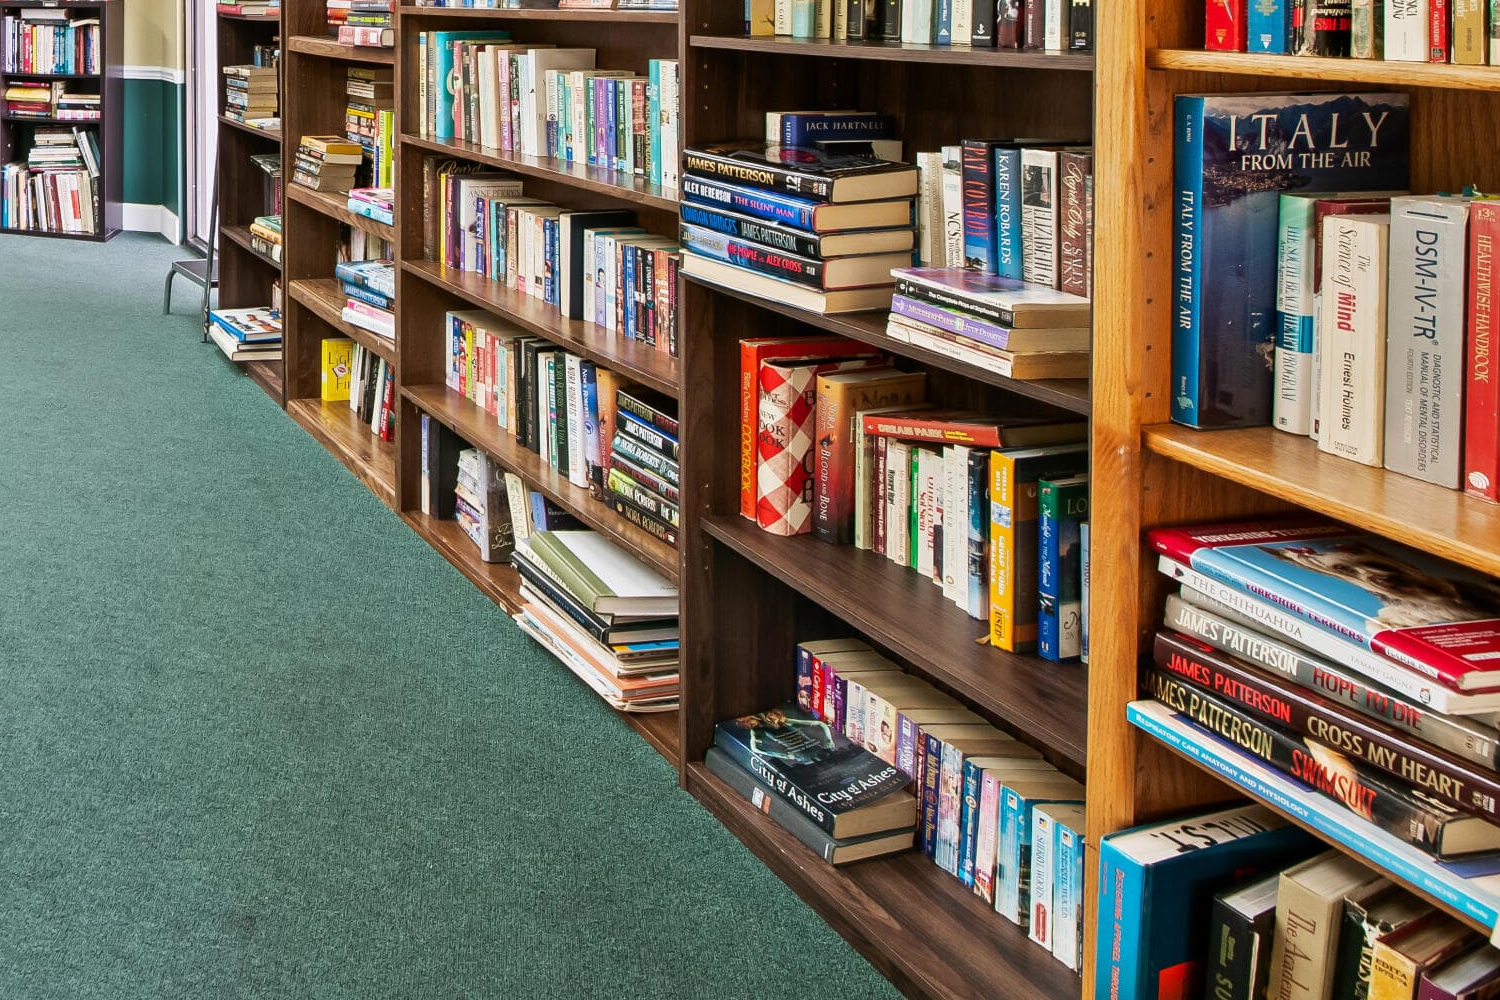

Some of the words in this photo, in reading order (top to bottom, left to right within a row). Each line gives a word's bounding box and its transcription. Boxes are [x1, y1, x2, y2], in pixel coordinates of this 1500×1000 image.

[806, 122, 829, 131] JACK
[1228, 113, 1388, 151] ITALY
[687, 157, 715, 171] JAMES
[717, 163, 775, 185] PATTERSON
[964, 146, 987, 173] PAT
[999, 155, 1009, 201] KAREN
[1241, 153, 1293, 171] FROM
[1299, 153, 1335, 168] THE
[1341, 152, 1371, 168] AIR
[684, 181, 699, 194] ALEX
[700, 185, 731, 203] BERENSON
[734, 196, 749, 206] THE
[750, 200, 774, 213] SILENT
[776, 207, 794, 218] MAN
[965, 180, 989, 240] CONROY
[1181, 190, 1193, 230] ITALY
[740, 222, 761, 240] JAMES
[760, 228, 797, 251] PATTERSON
[1000, 204, 1011, 264] ROBARDS
[1181, 232, 1193, 272] FROM
[1338, 226, 1357, 272] Science
[738, 246, 757, 261] PEOPLE
[766, 254, 780, 267] ALEX
[781, 258, 802, 272] CROSS
[1358, 255, 1370, 272] The
[1475, 234, 1492, 312] HEALTHWISE
[1180, 277, 1192, 303] THE
[1331, 275, 1356, 291] of
[1180, 306, 1192, 329] AIR
[1337, 292, 1356, 333] Mind
[1474, 312, 1490, 383] HANDBOOK
[1343, 352, 1355, 389] Ernest
[1421, 352, 1429, 385] MANUAL
[1432, 354, 1441, 401] DIAGNOSTIC
[1342, 391, 1354, 430] Holmes
[1419, 400, 1428, 429] MENTAL
[1432, 402, 1441, 418] AND
[916, 427, 943, 438] PARK
[1418, 431, 1427, 471] DISORDERS
[1430, 421, 1440, 464] STATISTICAL
[621, 440, 636, 456] NORA
[637, 448, 660, 468] ROBERTS
[742, 424, 752, 491] COOKBOOK
[820, 450, 831, 483] BLOOD
[619, 482, 634, 499] NORA
[635, 488, 656, 512] ROBERTS
[820, 495, 829, 520] BONE
[625, 506, 641, 524] NORA
[642, 514, 665, 537] ROBERTS
[1192, 575, 1216, 594] THE
[1219, 589, 1303, 638] CHIHUAHUA
[1245, 583, 1303, 615] YORKSHIRE
[1307, 612, 1363, 643] TERRIERS
[1175, 607, 1219, 641] JAMES
[1222, 628, 1300, 676] PATTERSON
[1313, 667, 1360, 701] HOPE
[1365, 688, 1388, 713] TO
[1392, 703, 1424, 731] DIE
[1142, 672, 1185, 714] JAMES
[1190, 694, 1272, 761] PATTERSON
[1291, 750, 1377, 818] SWIMSUIT
[1167, 653, 1211, 686] JAMES
[1215, 673, 1291, 723] PATTERSON
[1307, 716, 1363, 755] CROSS
[1368, 743, 1397, 771] MY
[1401, 756, 1465, 802] HEART
[1136, 713, 1181, 745] RESPIRATORY
[1182, 741, 1198, 756] CARE
[1201, 752, 1238, 777] ANATOMY
[1239, 775, 1257, 787] AND
[1258, 785, 1308, 818] PHYSIOLOGY
[751, 757, 774, 786] City
[776, 778, 788, 791] of
[788, 786, 824, 822] Ashes
[818, 791, 847, 804] City
[849, 784, 859, 795] of
[858, 766, 897, 790] Ashes
[1286, 909, 1316, 938] The
[1376, 958, 1407, 979] EDITA
